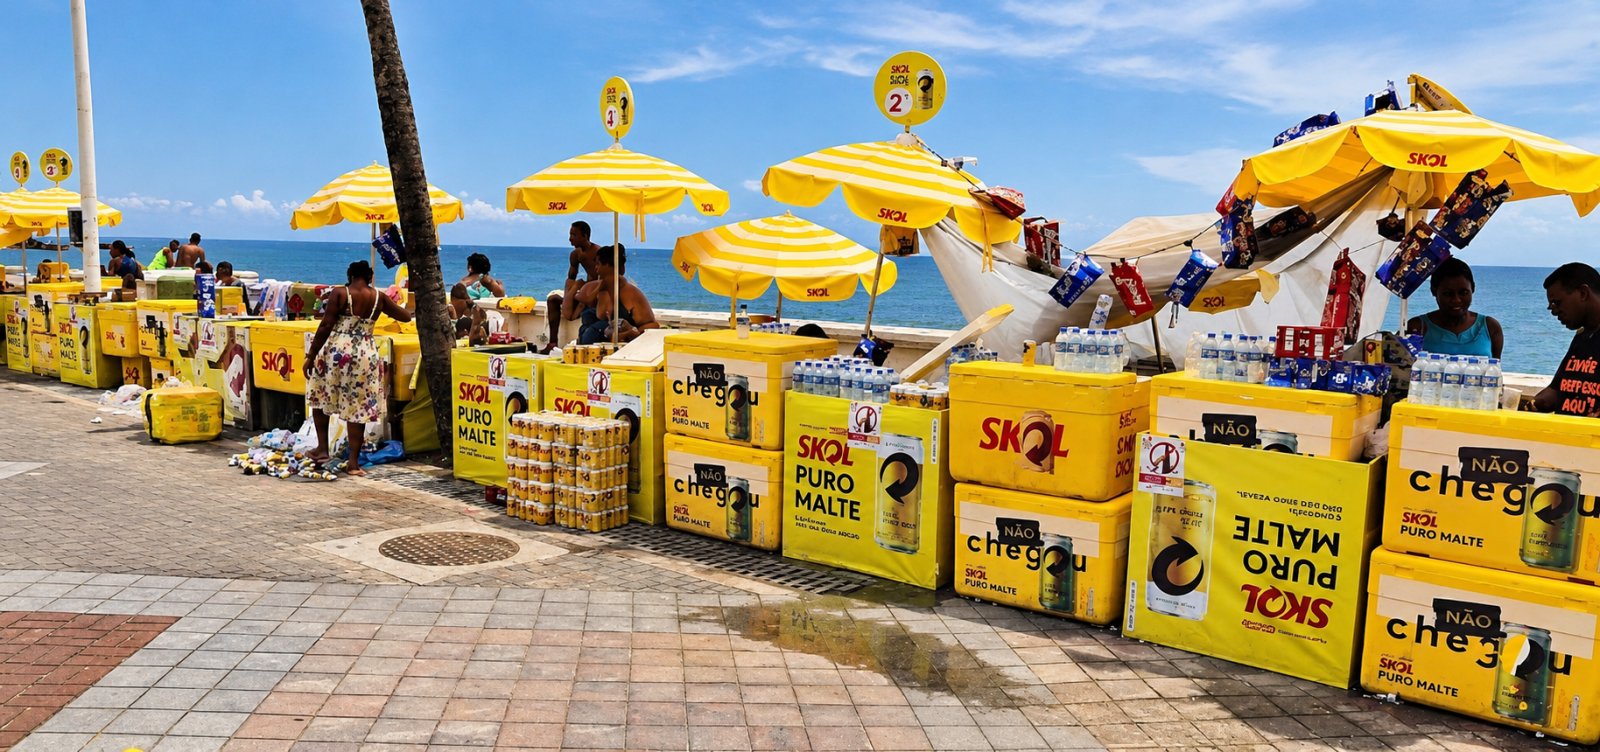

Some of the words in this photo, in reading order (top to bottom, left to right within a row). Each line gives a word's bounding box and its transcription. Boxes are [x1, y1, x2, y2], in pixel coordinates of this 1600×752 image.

[889, 93, 903, 112] 2
[1407, 152, 1449, 168] SKOL
[548, 201, 568, 211] SKOL
[878, 207, 908, 223] SKOL
[806, 288, 830, 297] SKOL
[261, 351, 295, 378] SKOL
[700, 367, 721, 380] NÃO
[459, 381, 491, 405] SKOL
[458, 405, 492, 426] PURO
[672, 417, 689, 425] PURO
[690, 420, 710, 429] MALTE
[459, 425, 496, 447] MALTE
[1212, 418, 1250, 437] NÃO
[797, 434, 854, 467] SKOL
[979, 416, 1070, 467] SKOL
[700, 468, 722, 481] NÃO
[1471, 455, 1520, 475] NÃO
[796, 464, 855, 494] PURO
[795, 489, 861, 521] MALTE
[690, 518, 711, 528] MALTE
[1402, 511, 1438, 528] SKOL
[1004, 523, 1035, 539] NÃO
[1233, 515, 1340, 557] MALTE
[1400, 525, 1437, 540] PURO
[1440, 532, 1484, 548] MALTE
[965, 567, 988, 580] SKOL
[1243, 549, 1337, 590] PURO
[965, 578, 988, 589] PURO
[990, 584, 1017, 595] MALTE
[1241, 583, 1333, 629] SKOL
[1445, 608, 1492, 629] NÃO
[1379, 657, 1414, 675] SKOL
[1378, 670, 1413, 686] PURO
[1416, 680, 1459, 697] MALTE
